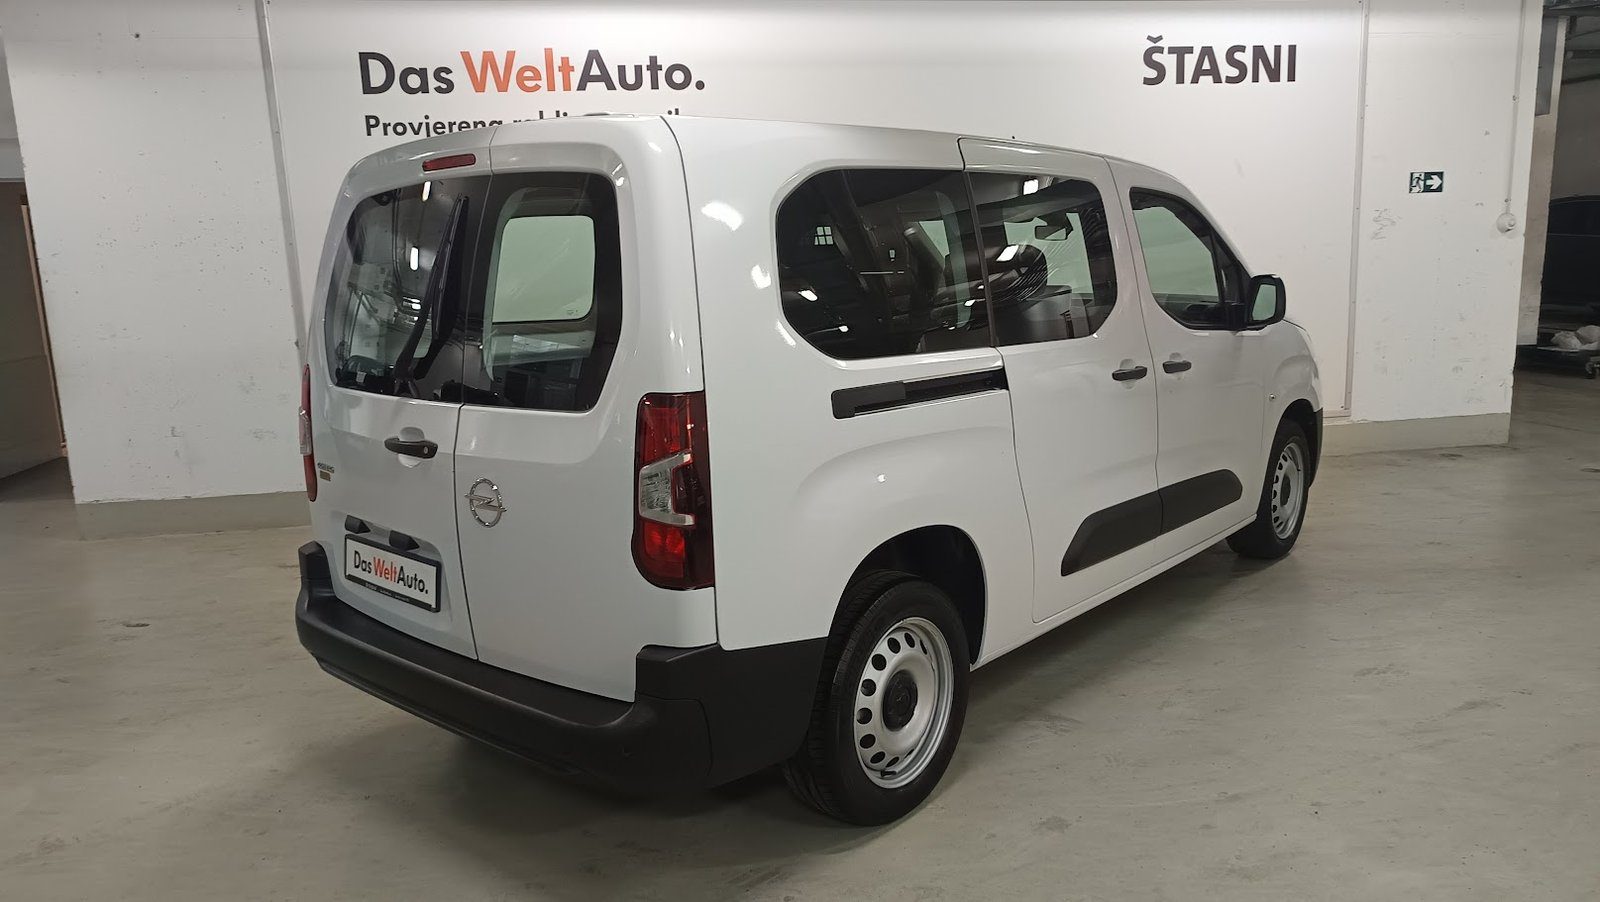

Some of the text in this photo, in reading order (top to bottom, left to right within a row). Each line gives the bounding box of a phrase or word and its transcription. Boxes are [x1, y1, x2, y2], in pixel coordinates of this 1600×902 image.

[358, 48, 705, 95] Das WeltAuto.
[1142, 35, 1297, 85] ŠTASNI
